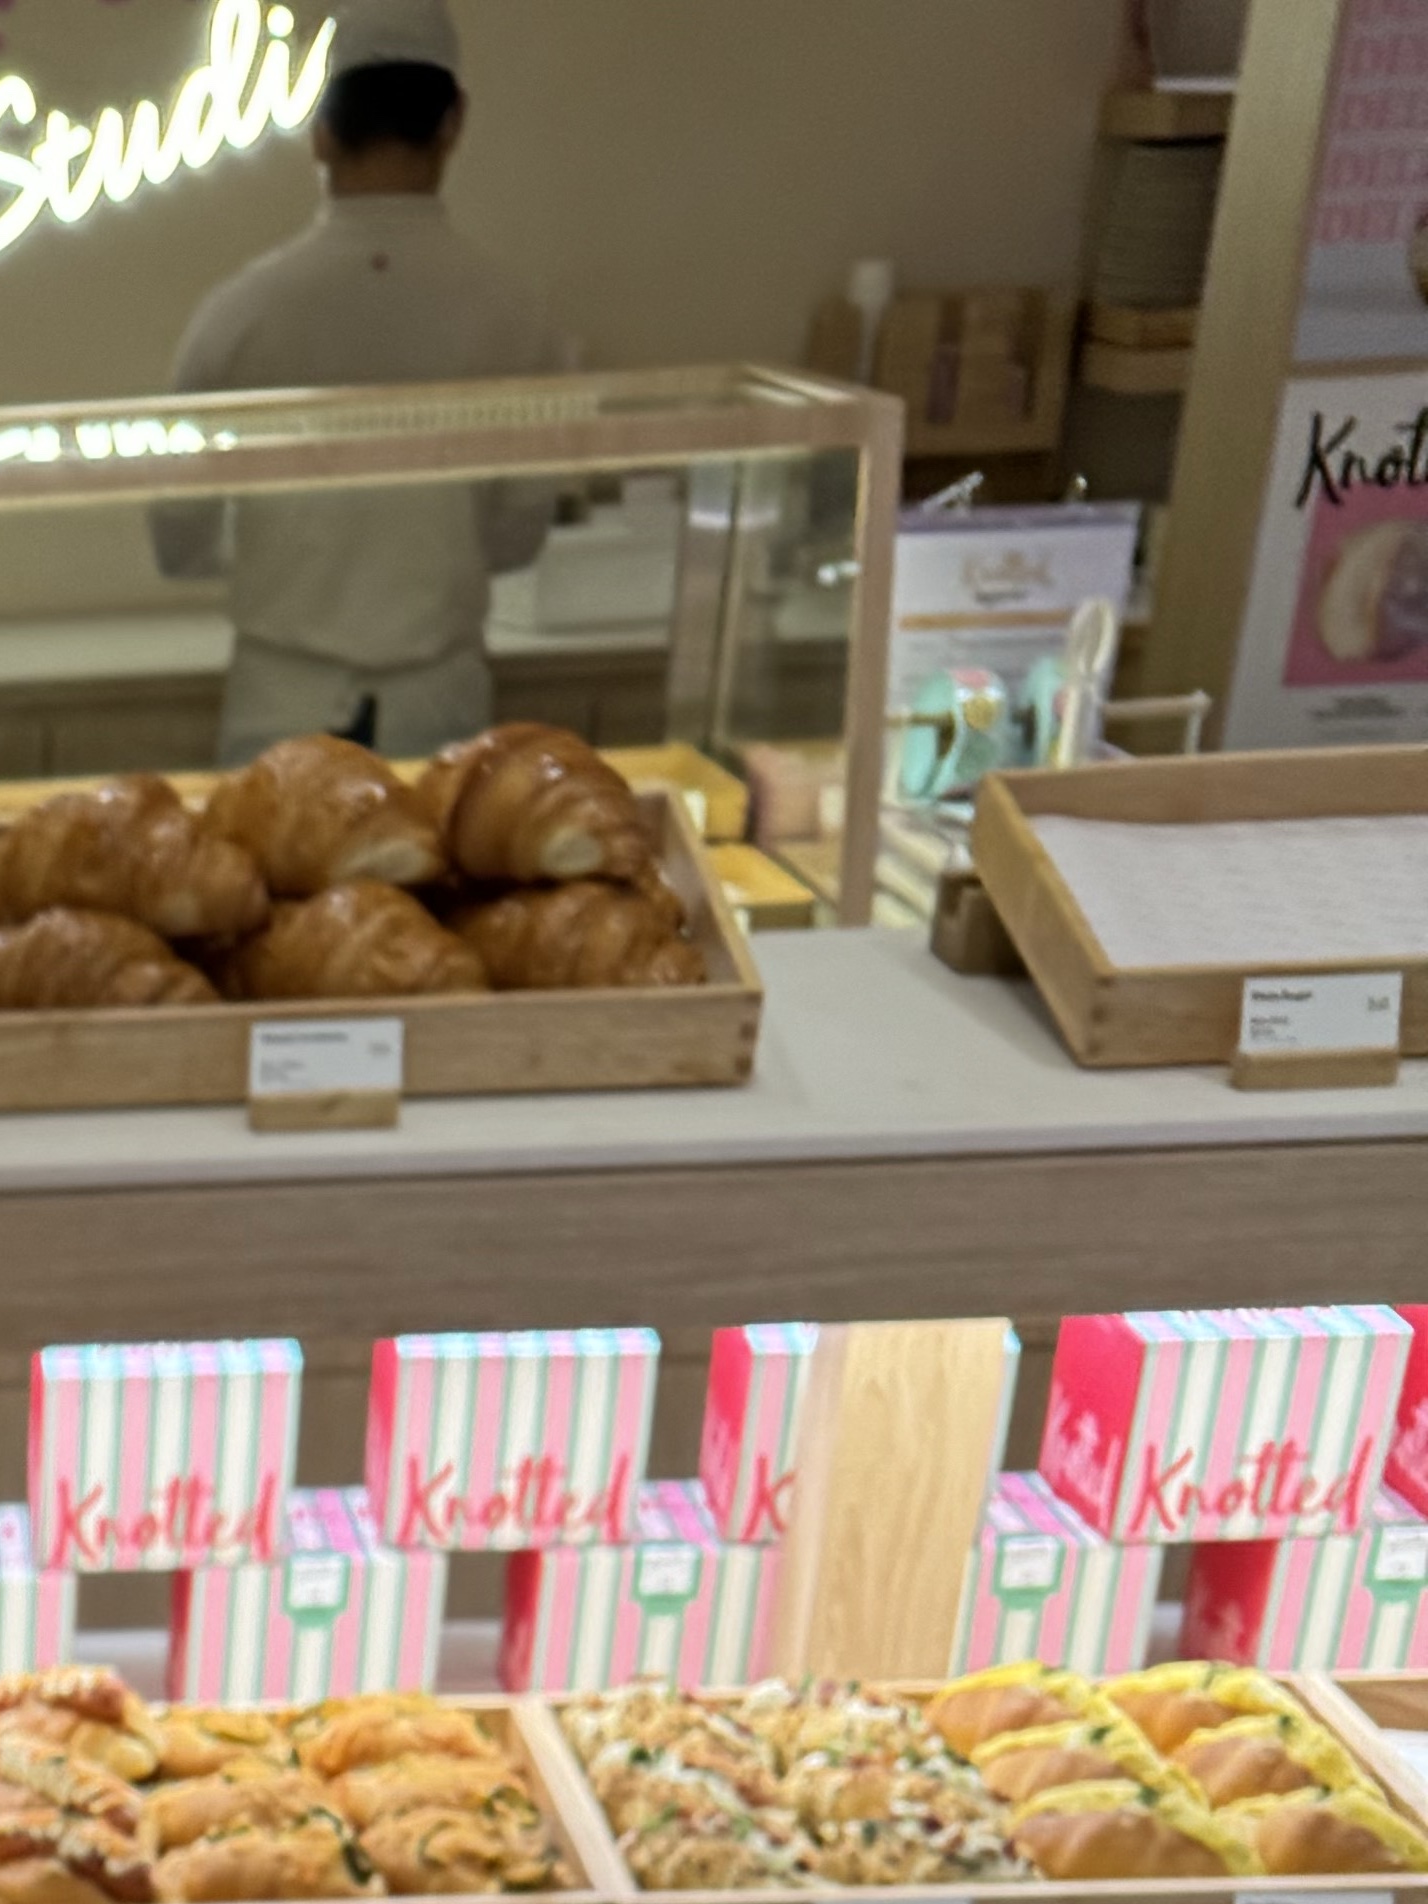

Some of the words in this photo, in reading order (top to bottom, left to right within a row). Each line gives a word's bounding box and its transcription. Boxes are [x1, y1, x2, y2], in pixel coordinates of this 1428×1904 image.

[1294, 405, 1428, 510] Knot
[46, 1474, 277, 1571] Knotted
[394, 1452, 632, 1548] Knotted
[1128, 1436, 1375, 1535] Knotted
